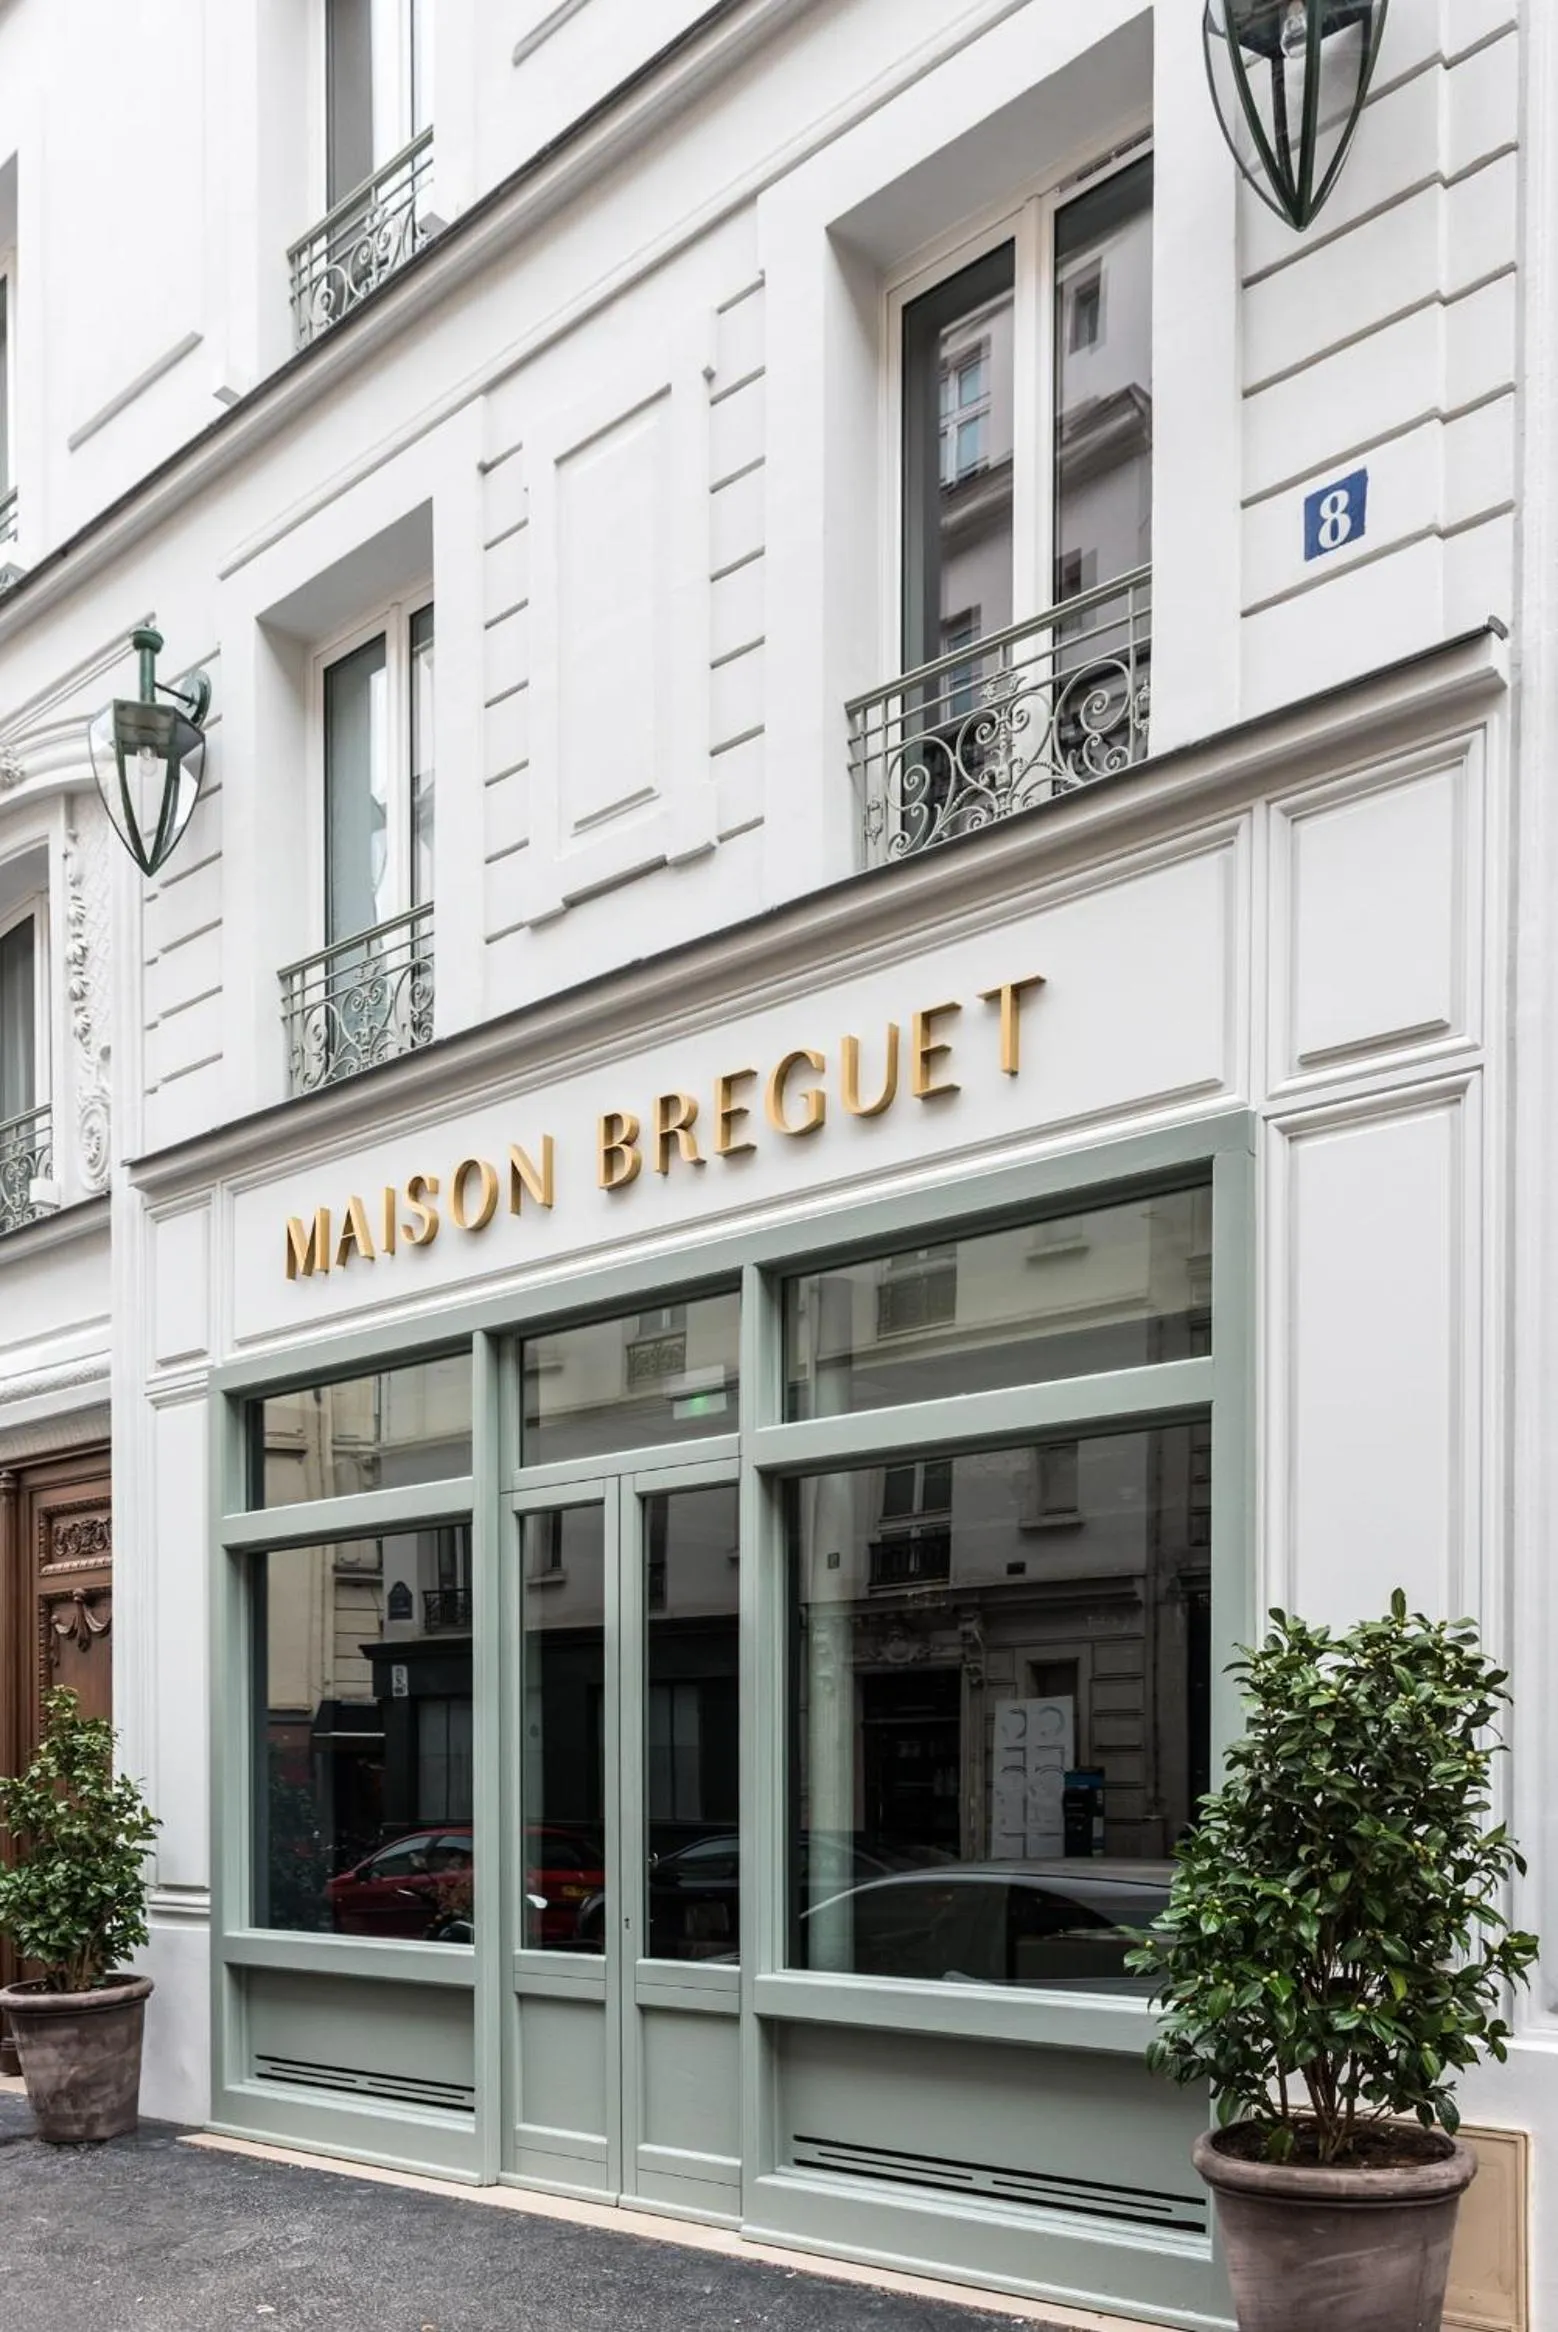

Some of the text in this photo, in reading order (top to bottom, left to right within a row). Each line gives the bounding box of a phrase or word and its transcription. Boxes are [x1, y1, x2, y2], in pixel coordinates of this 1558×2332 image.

[1318, 489, 1351, 549] 8
[286, 975, 1047, 1282] MAISON BREGUET
